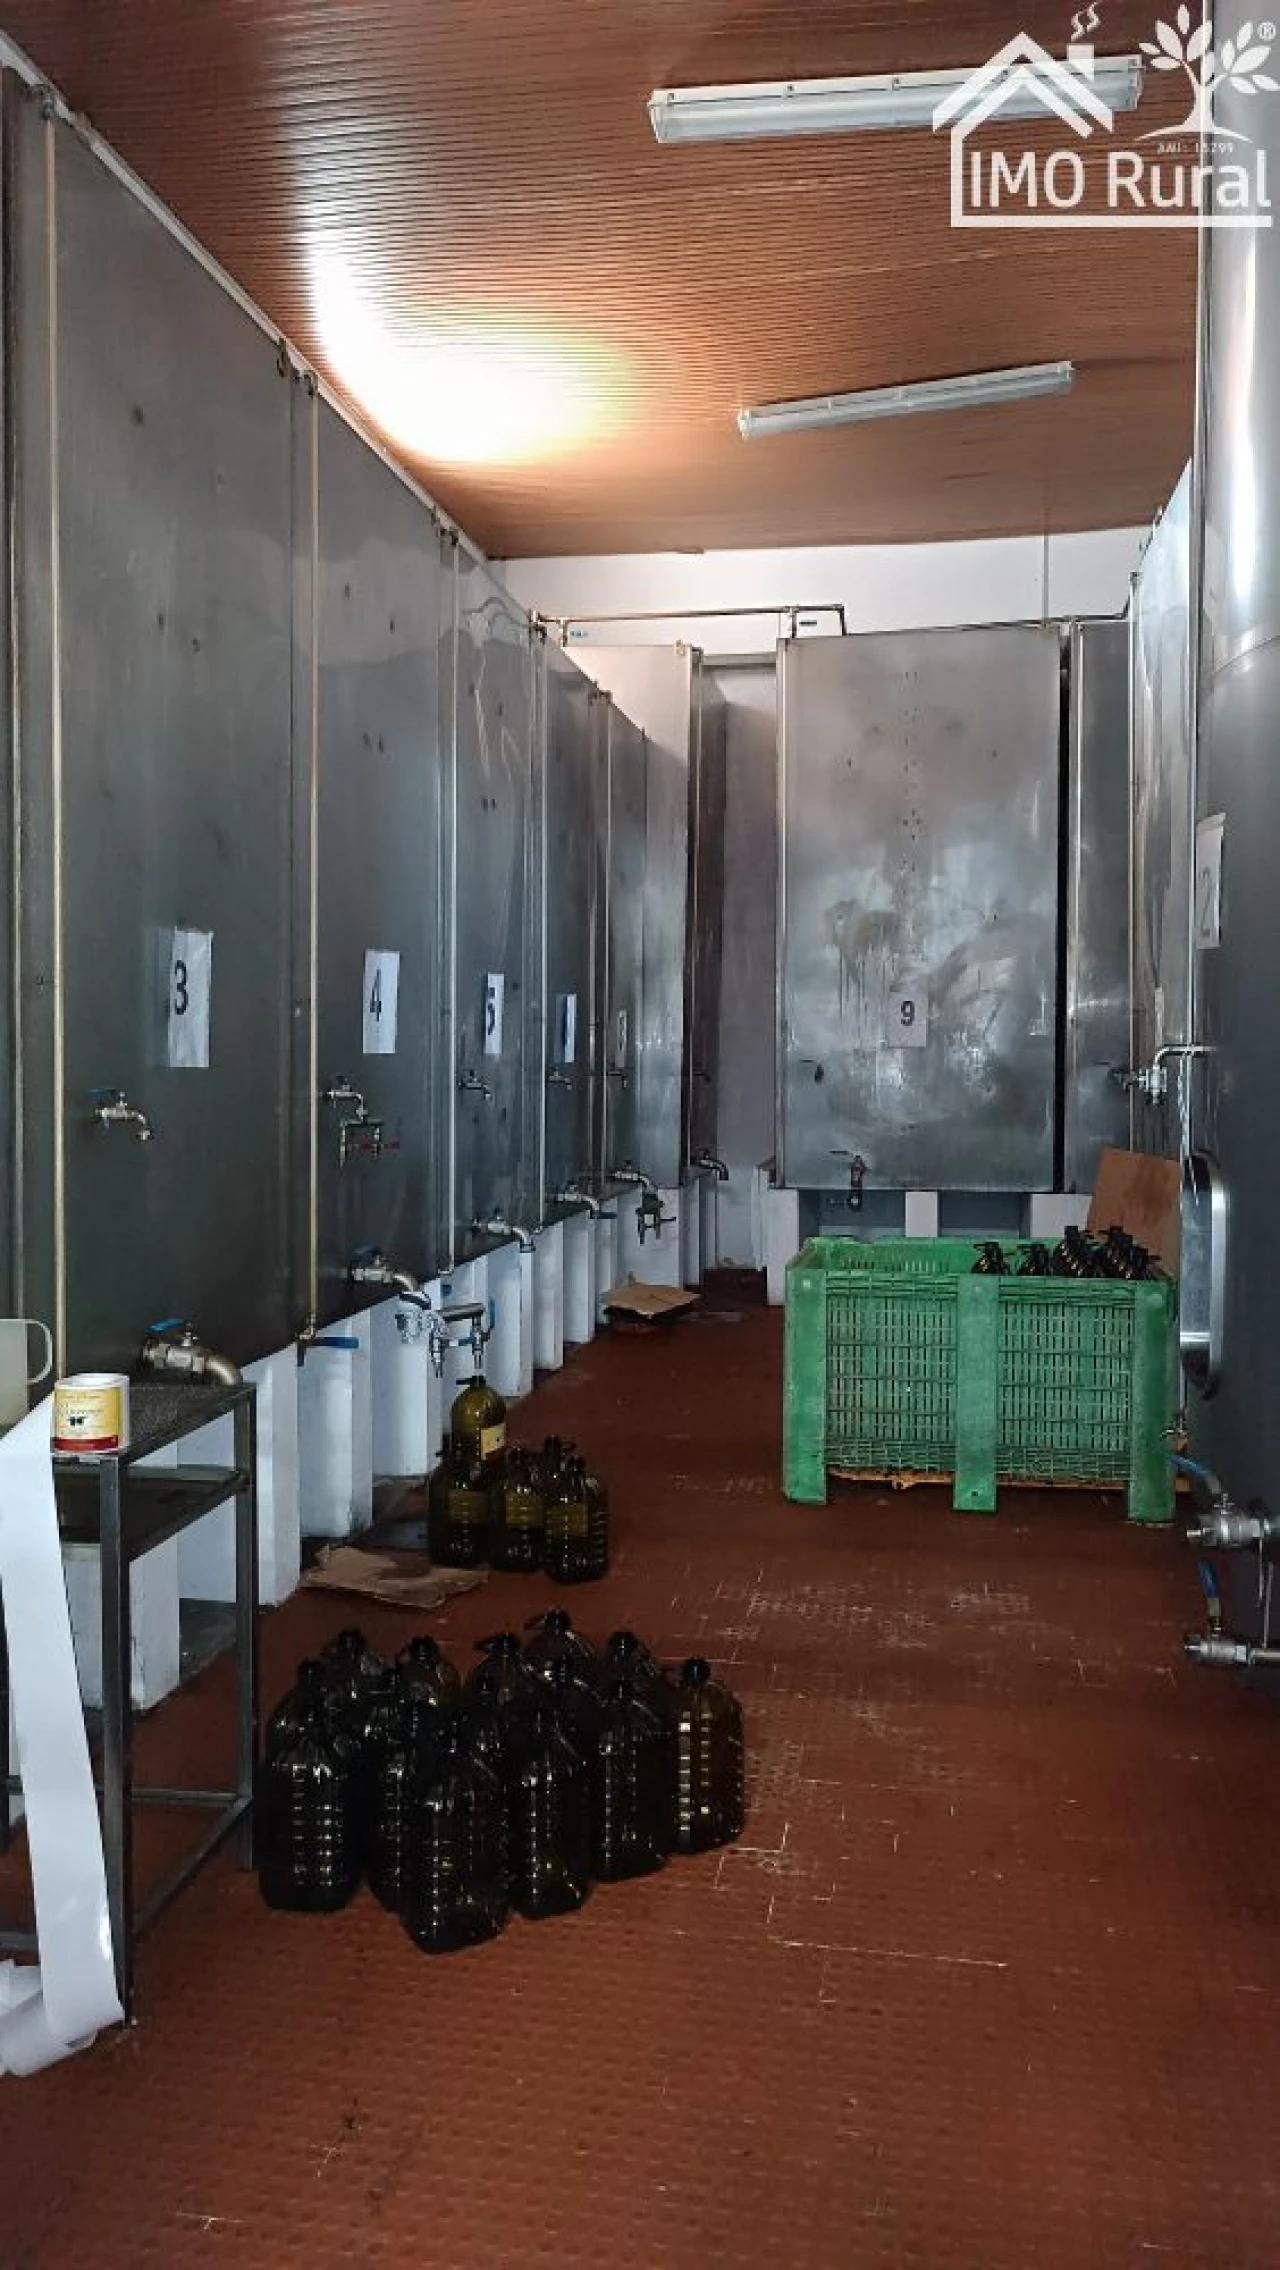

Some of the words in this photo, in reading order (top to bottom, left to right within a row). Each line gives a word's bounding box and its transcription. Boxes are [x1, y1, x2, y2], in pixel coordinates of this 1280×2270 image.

[174, 960, 189, 1015] 3
[369, 969, 382, 1022] 4
[901, 1000, 915, 1026] 9
